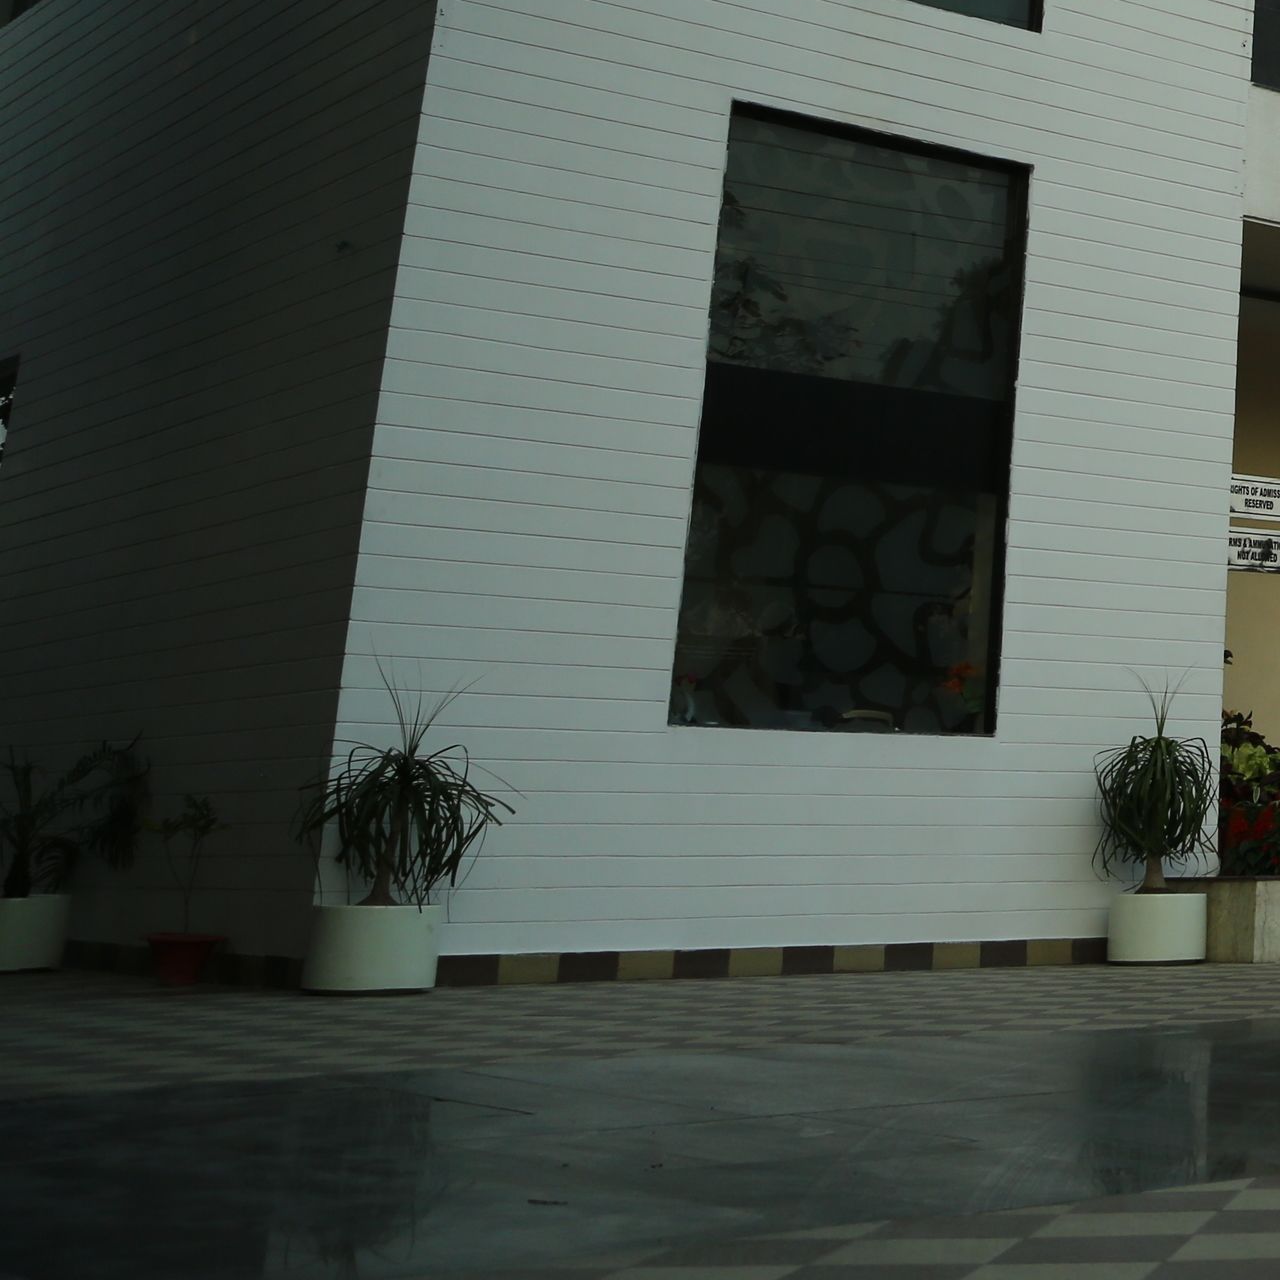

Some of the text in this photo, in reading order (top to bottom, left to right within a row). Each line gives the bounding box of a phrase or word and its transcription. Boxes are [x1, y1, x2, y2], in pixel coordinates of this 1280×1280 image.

[1250, 487, 1259, 497] OF
[1244, 498, 1274, 510] RESERVED
[1237, 549, 1249, 560] NOT
